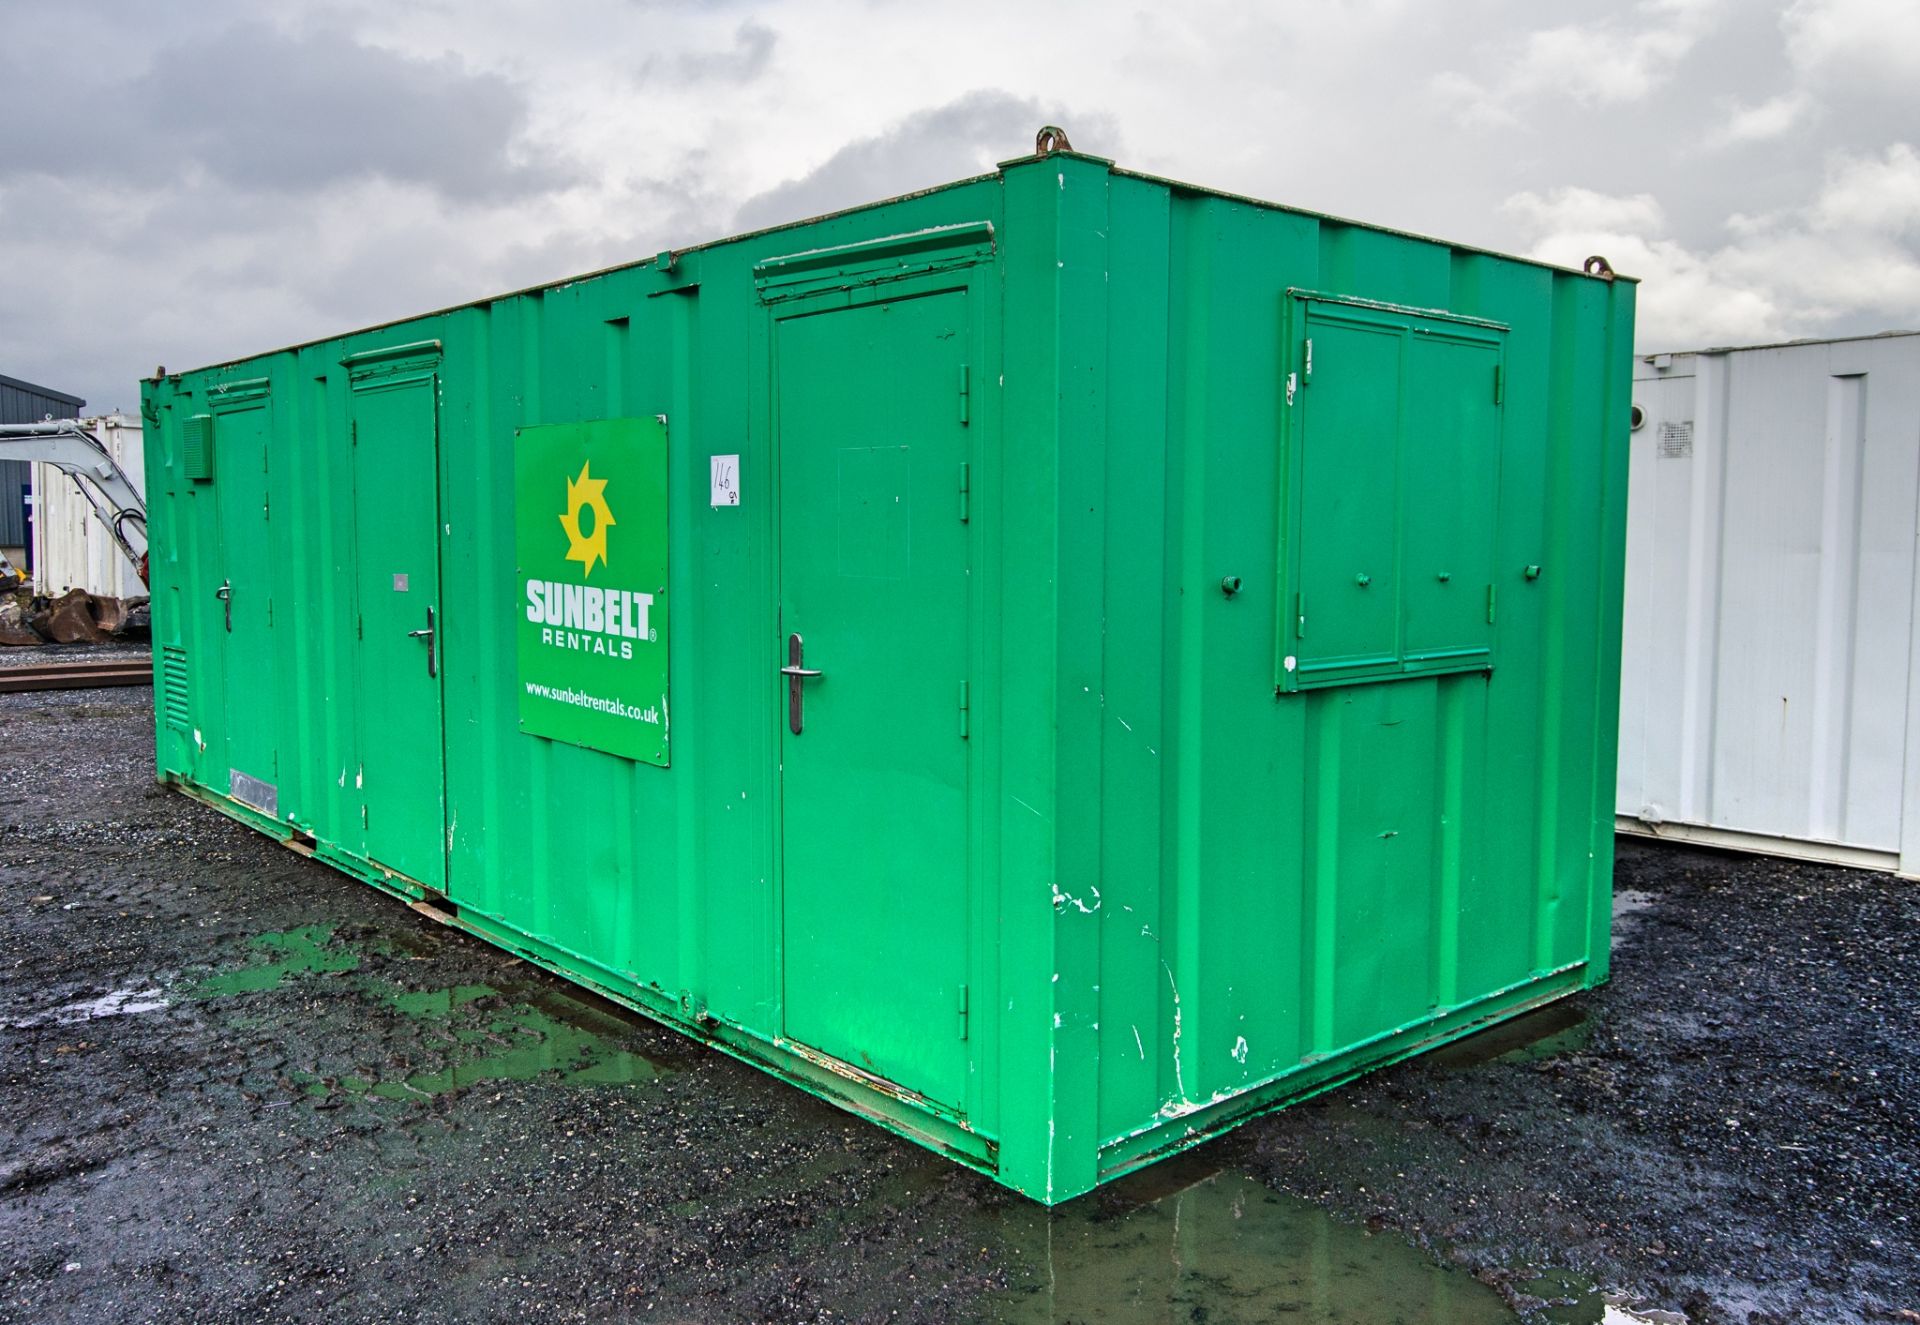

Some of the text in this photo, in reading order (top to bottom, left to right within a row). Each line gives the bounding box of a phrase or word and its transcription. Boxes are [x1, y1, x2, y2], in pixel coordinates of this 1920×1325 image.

[714, 462, 731, 491] 146
[526, 579, 654, 641] SUNBELT
[542, 628, 633, 660] RENTALS
[526, 682, 659, 725] www.sunbeltrentals.co.uk
